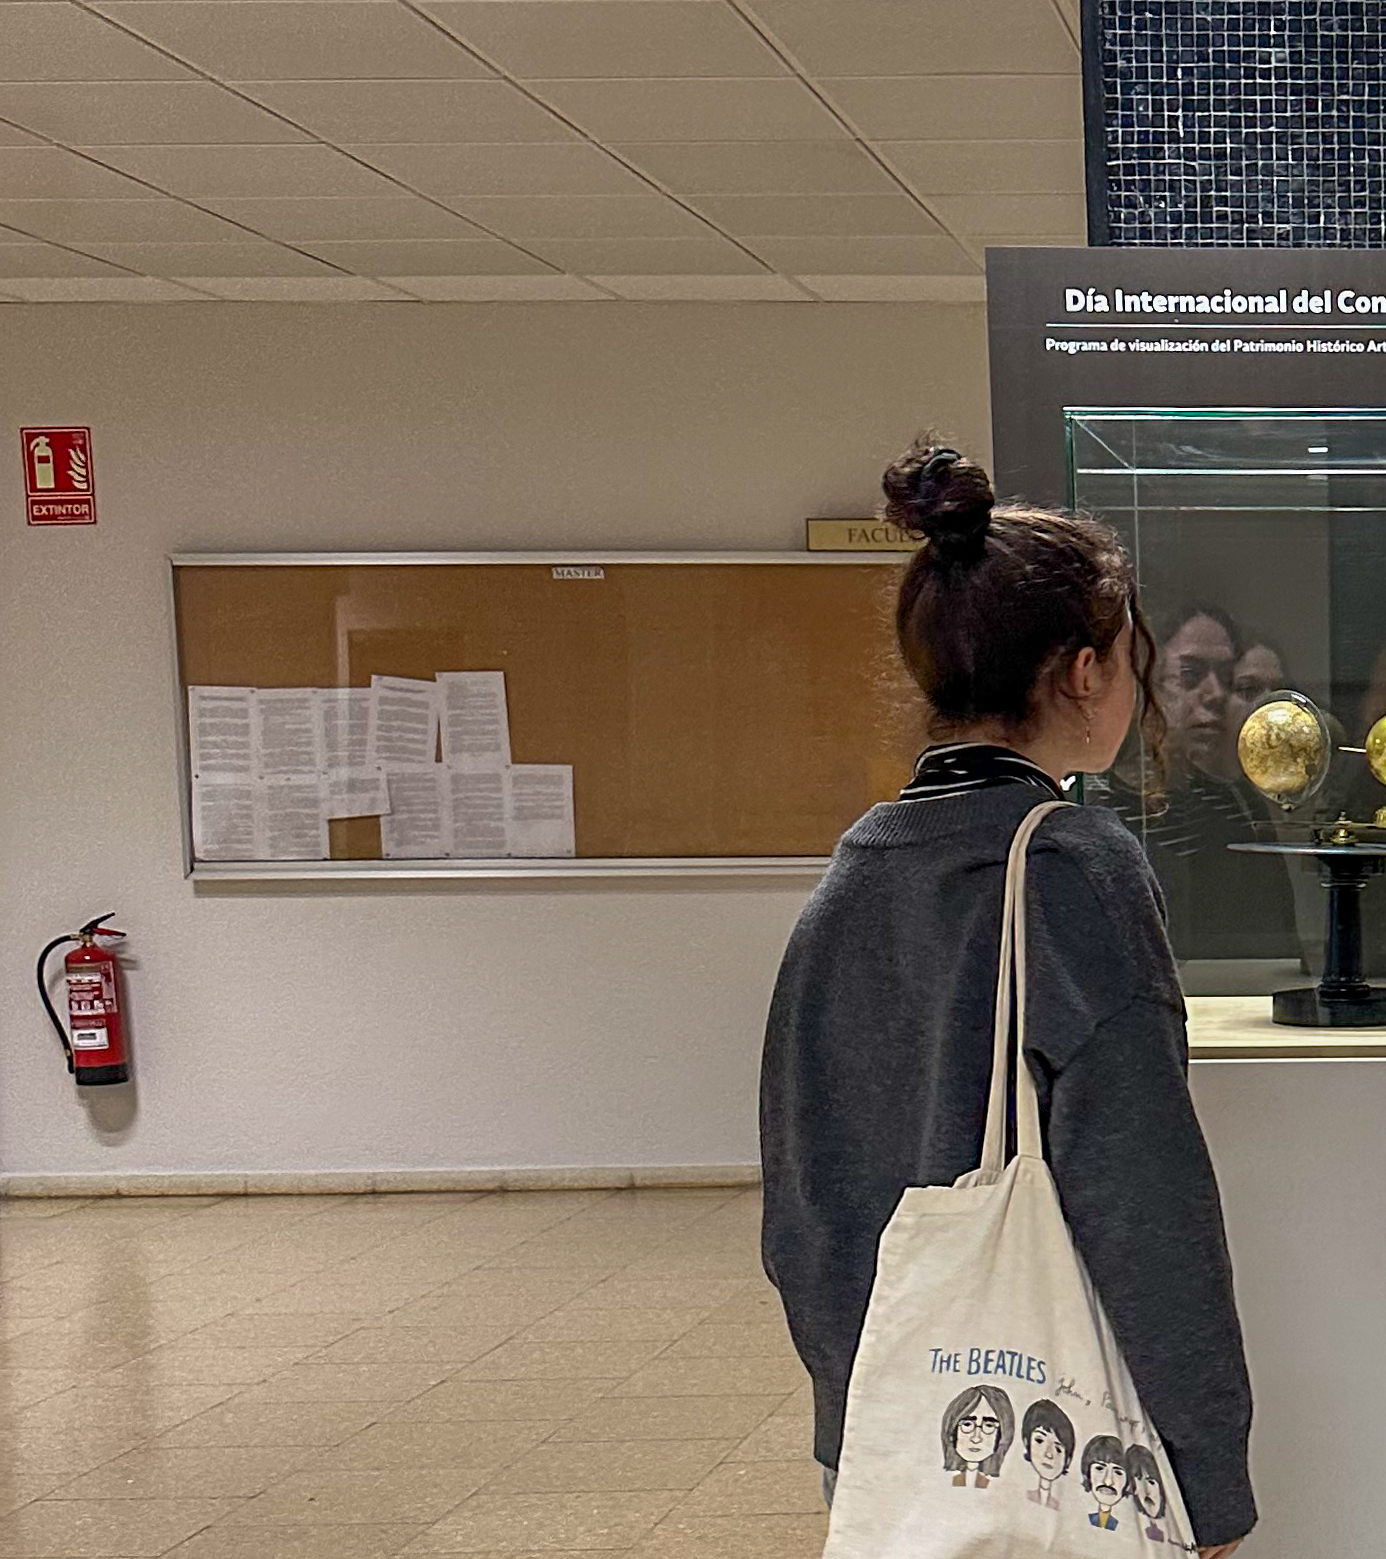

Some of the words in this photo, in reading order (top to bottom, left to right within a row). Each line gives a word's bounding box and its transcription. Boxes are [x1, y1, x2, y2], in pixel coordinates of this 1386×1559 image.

[1065, 288, 1110, 313] Día
[1115, 288, 1287, 314] Internacional
[1292, 289, 1332, 314] del
[1045, 337, 1109, 355] Programa
[1109, 338, 1127, 352] de
[1128, 338, 1209, 352] visualización
[1211, 339, 1231, 353] del
[1233, 339, 1304, 353] Patrimonio
[1306, 339, 1365, 353] Histórico
[32, 504, 90, 516] EXTINTOR
[929, 1348, 962, 1374] THE
[966, 1347, 1047, 1385] BEATLES
